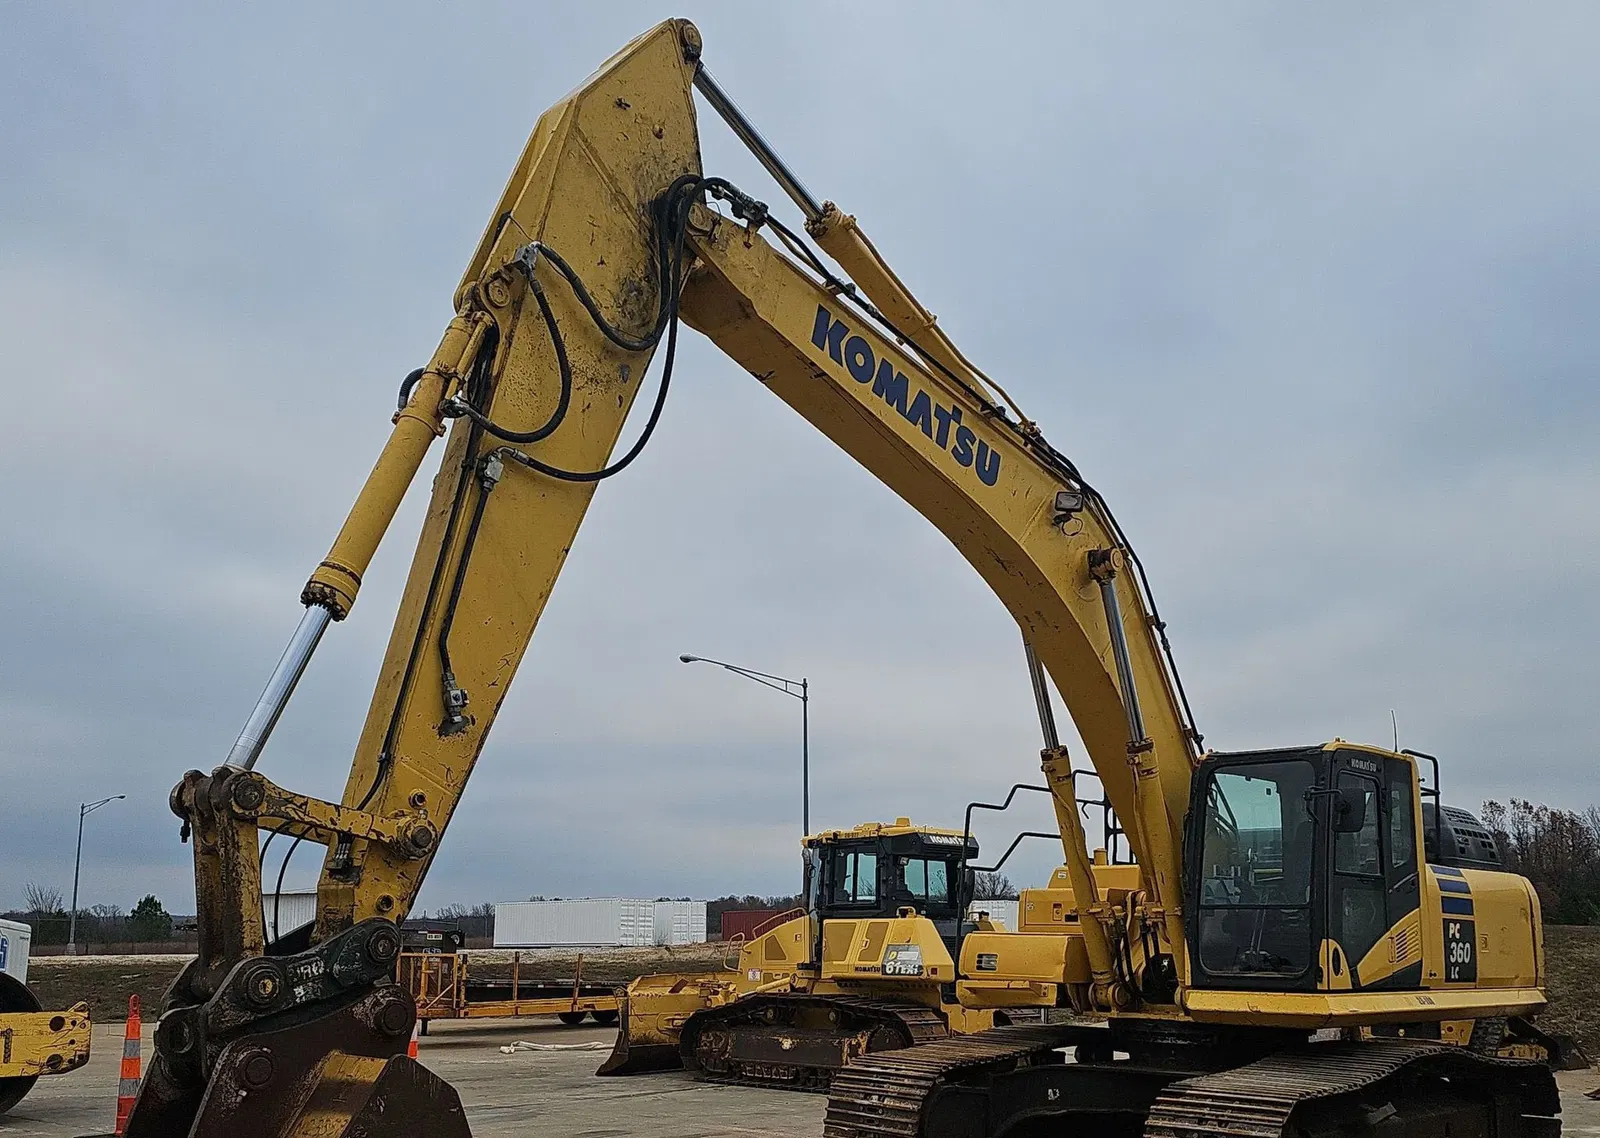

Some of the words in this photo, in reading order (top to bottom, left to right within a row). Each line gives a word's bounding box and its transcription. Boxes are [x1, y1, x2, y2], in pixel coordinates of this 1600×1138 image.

[811, 303, 1001, 487] KOMATSU
[1351, 758, 1377, 772] KOMATSU
[930, 835, 970, 846] KOMATS
[1449, 922, 1460, 939] PC
[1450, 941, 1471, 964] 360
[854, 964, 881, 973] KOMATSU
[1451, 966, 1460, 979] LC
